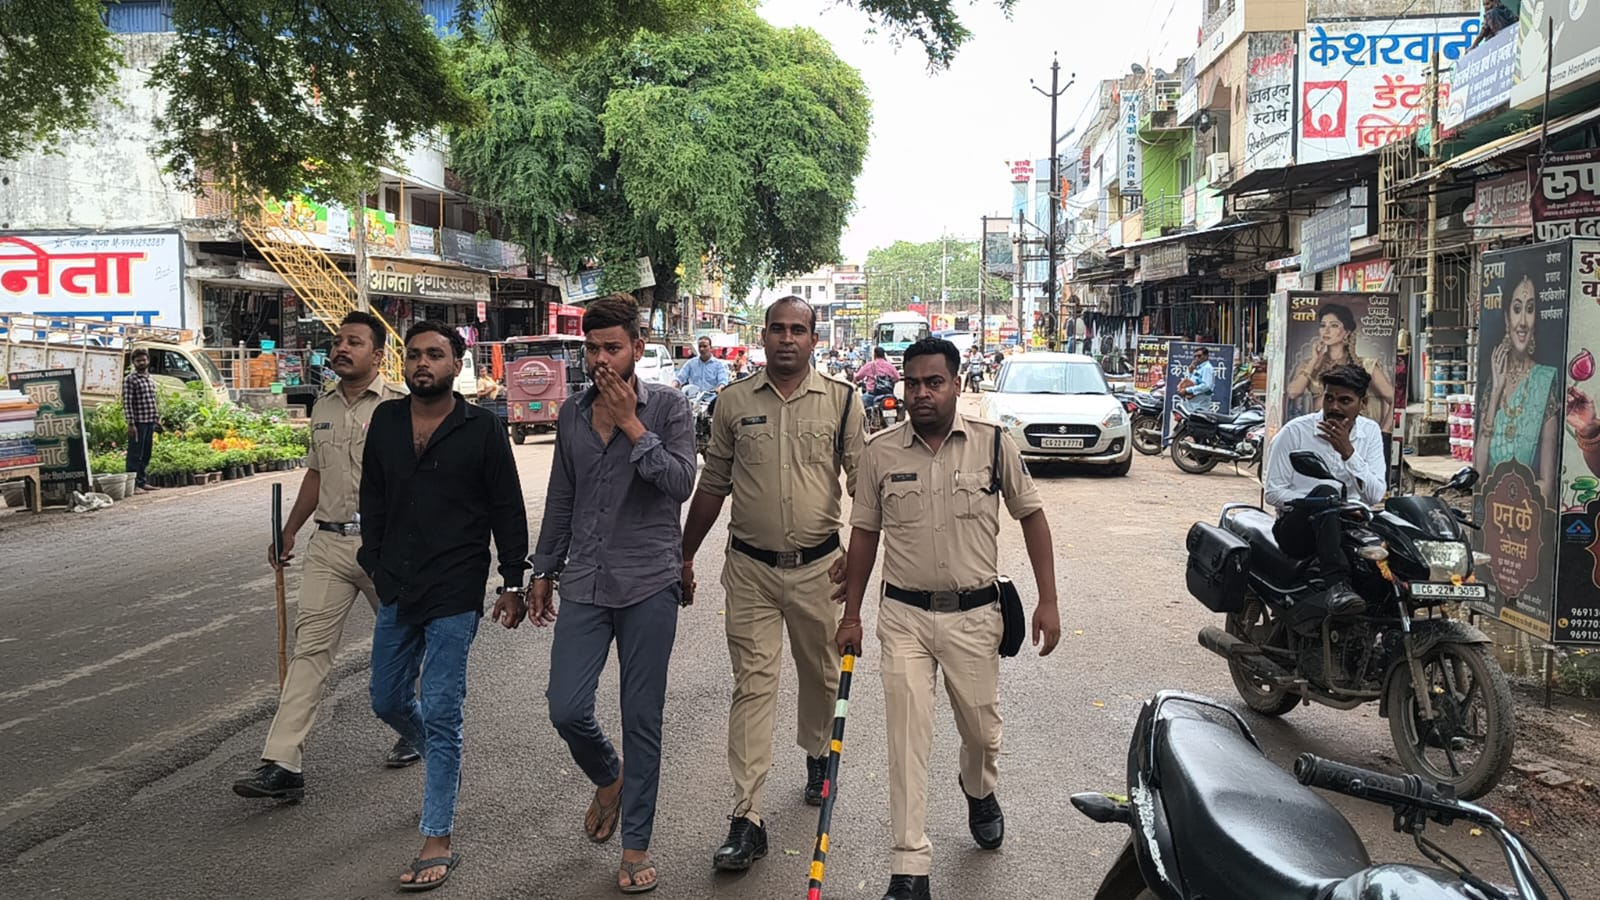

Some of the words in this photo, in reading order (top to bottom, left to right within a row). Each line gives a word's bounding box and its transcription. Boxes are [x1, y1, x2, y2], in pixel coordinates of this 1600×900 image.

[369, 263, 413, 293] अनिता
[1483, 285, 1503, 310] वाले
[1292, 309, 1317, 321] वाले
[1493, 502, 1514, 534] एन
[1515, 499, 1533, 532] के
[1421, 585, 1433, 593] CG
[1571, 607, 1600, 617] 96913
[1570, 618, 1600, 629] 99770
[1570, 630, 1600, 640] 96910
